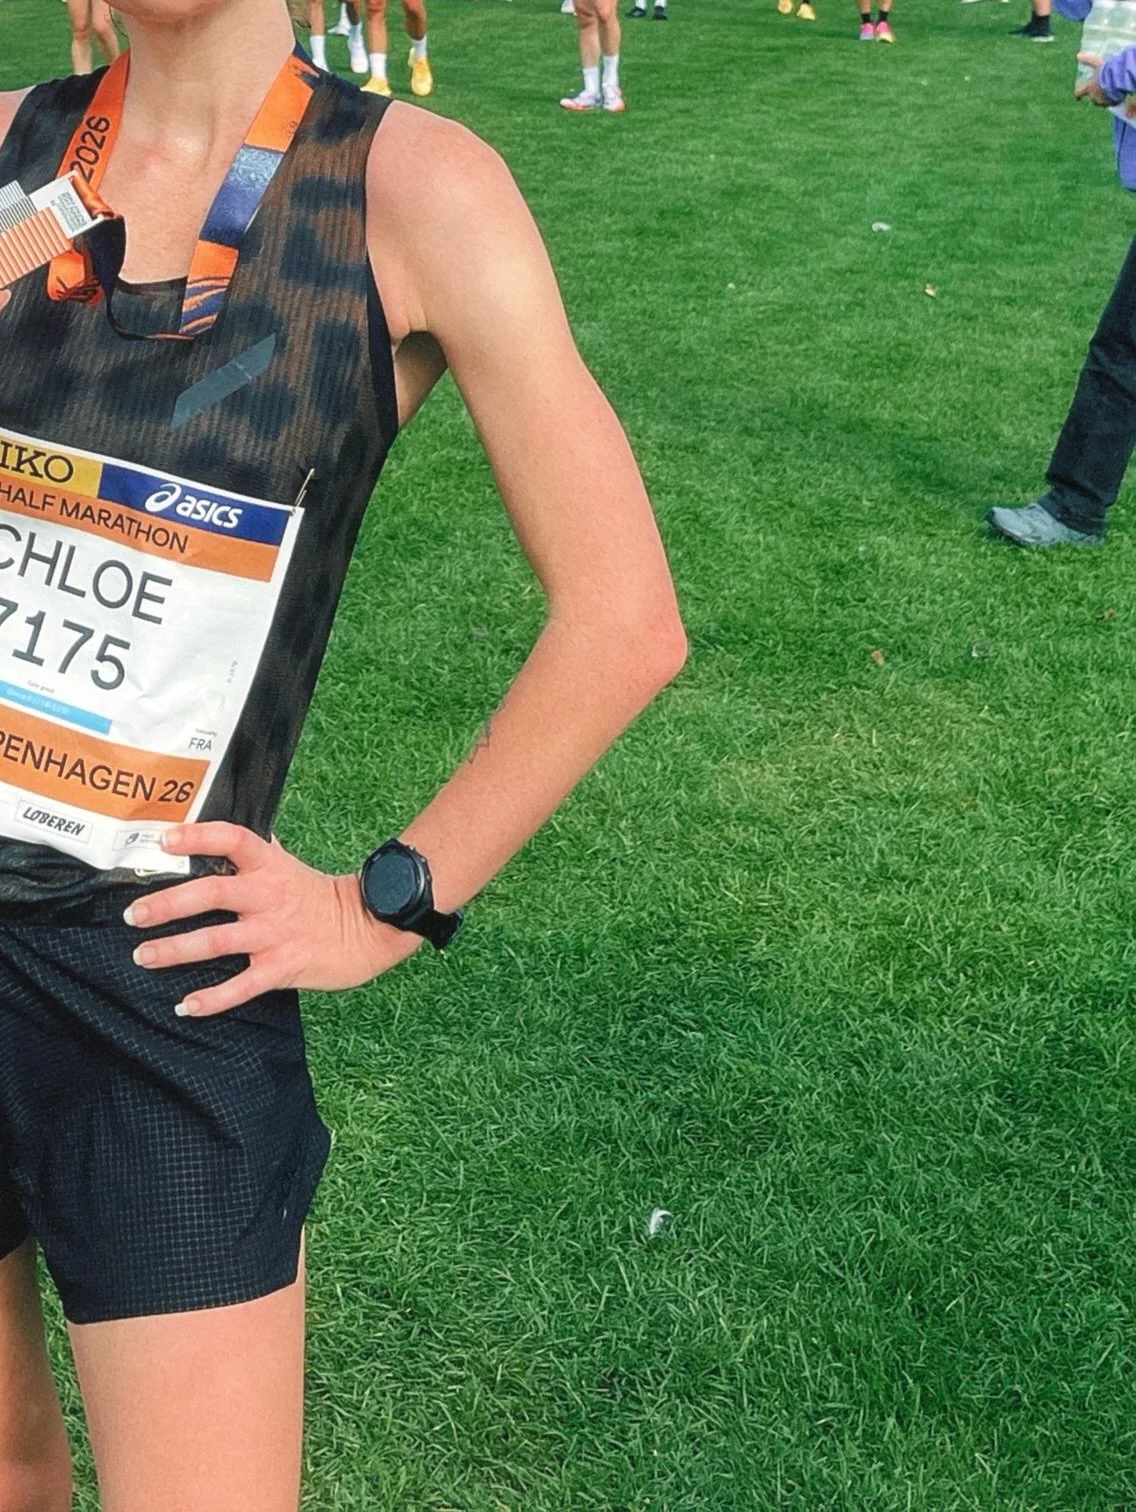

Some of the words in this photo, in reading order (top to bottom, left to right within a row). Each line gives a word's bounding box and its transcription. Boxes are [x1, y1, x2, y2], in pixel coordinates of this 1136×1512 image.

[70, 116, 110, 184] 2026
[59, 498, 189, 554] MARATHON
[188, 737, 213, 752] FRA
[158, 779, 194, 804] 26
